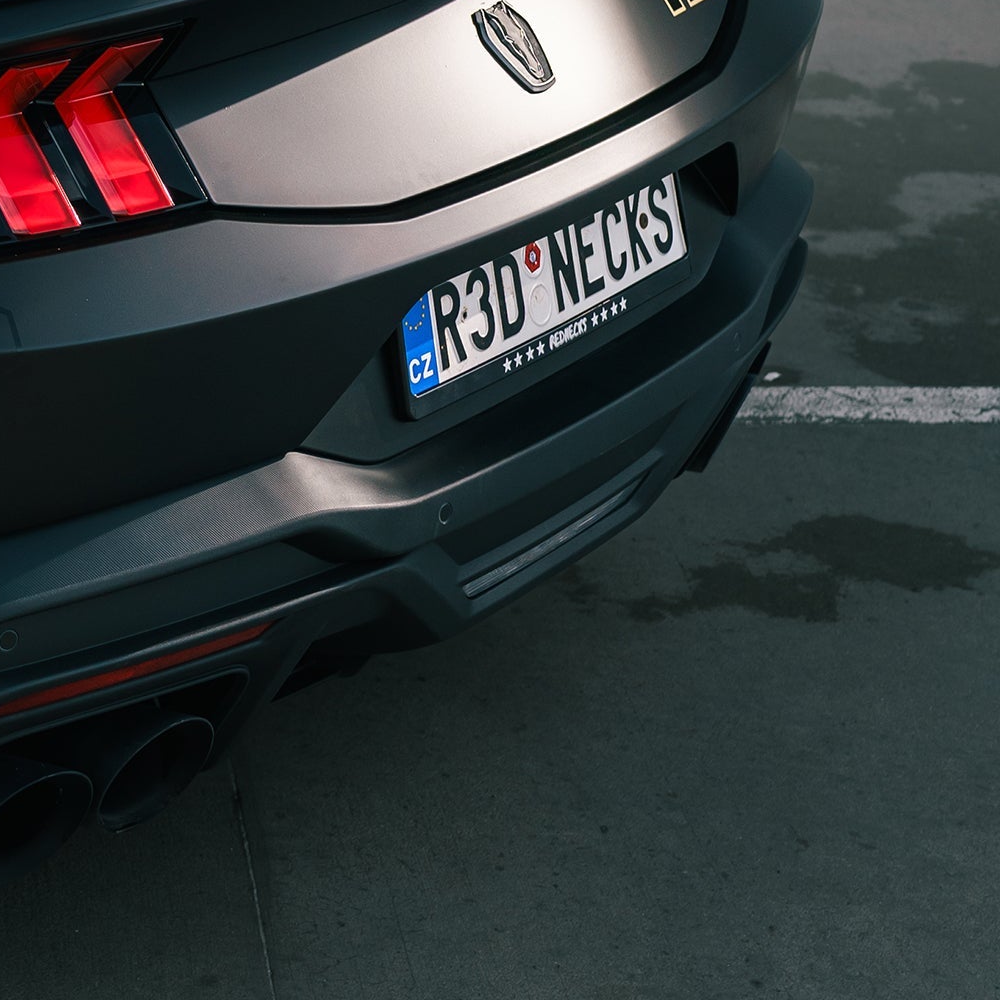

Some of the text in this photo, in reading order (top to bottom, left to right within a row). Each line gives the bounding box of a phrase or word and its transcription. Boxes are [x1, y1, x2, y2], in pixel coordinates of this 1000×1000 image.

[430, 178, 674, 372] R3D NECKS
[549, 316, 588, 351] REDNECKS
[408, 352, 435, 384] CZ
